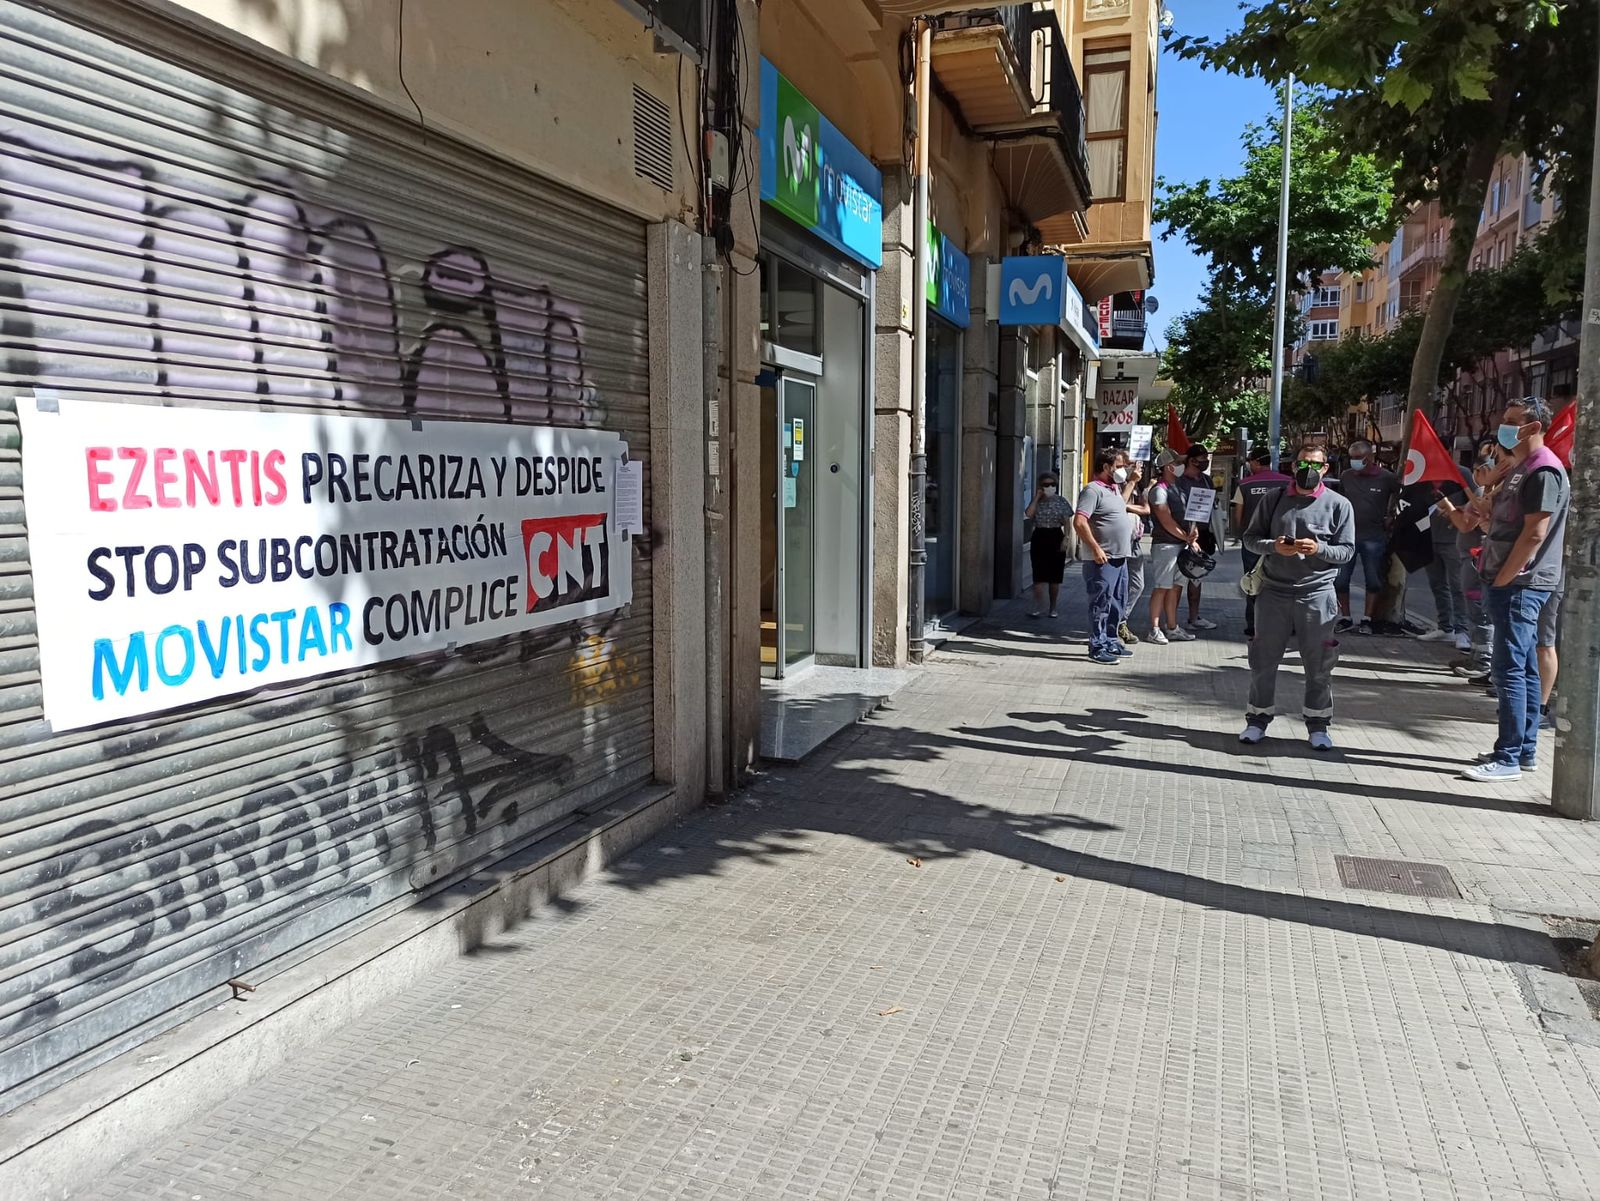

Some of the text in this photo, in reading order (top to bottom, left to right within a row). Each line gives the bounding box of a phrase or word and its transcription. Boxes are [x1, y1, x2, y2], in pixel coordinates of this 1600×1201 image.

[1101, 411, 1133, 425] 2008
[1103, 390, 1134, 406] BAZAR
[85, 446, 606, 512] EZENTIS PRECARIZA Y DESPIDE
[87, 513, 508, 602] STOP SUBCONTRATACIÓN
[529, 521, 609, 600] CNT
[91, 575, 519, 701] MOVISTAR COMPLICE
